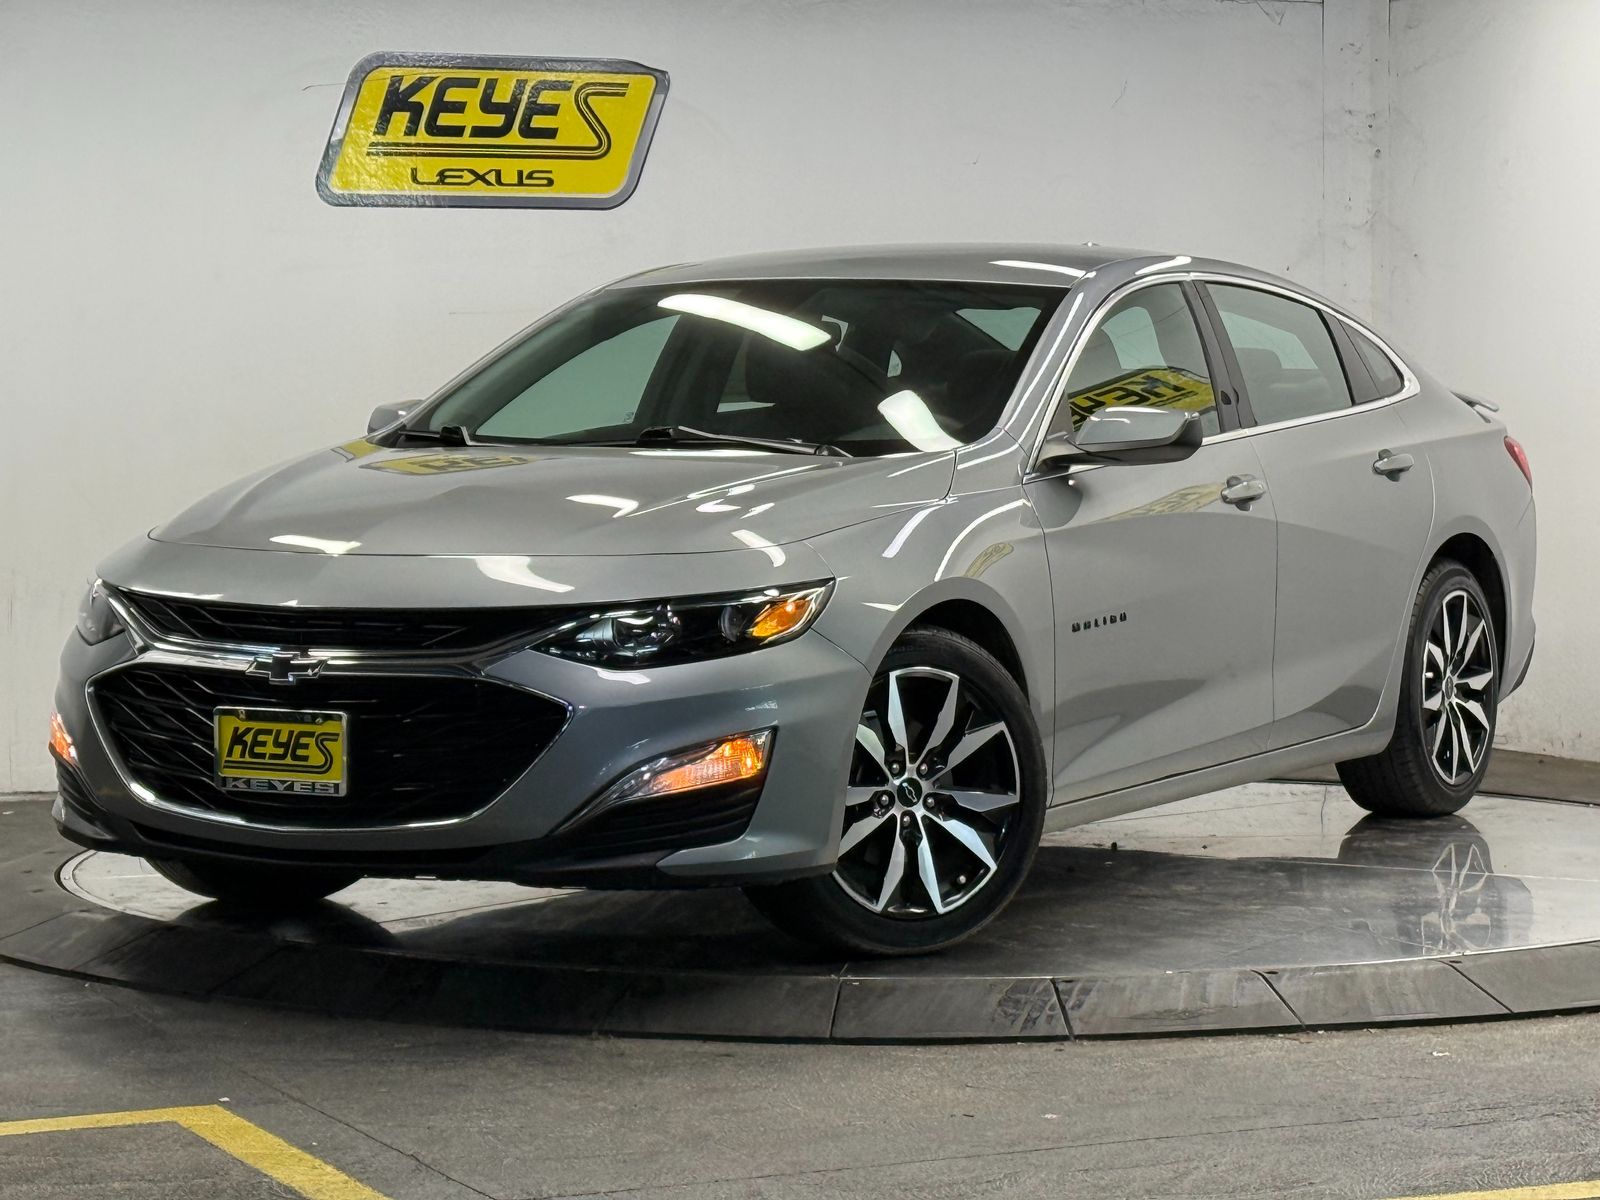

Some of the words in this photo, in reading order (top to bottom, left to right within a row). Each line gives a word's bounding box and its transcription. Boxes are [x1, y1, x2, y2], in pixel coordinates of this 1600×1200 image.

[366, 74, 629, 160] KEYES
[411, 167, 554, 187] LEXUS
[1071, 611, 1127, 632] MALIBU
[223, 726, 340, 774] KEYES
[226, 778, 335, 793] KEYES
